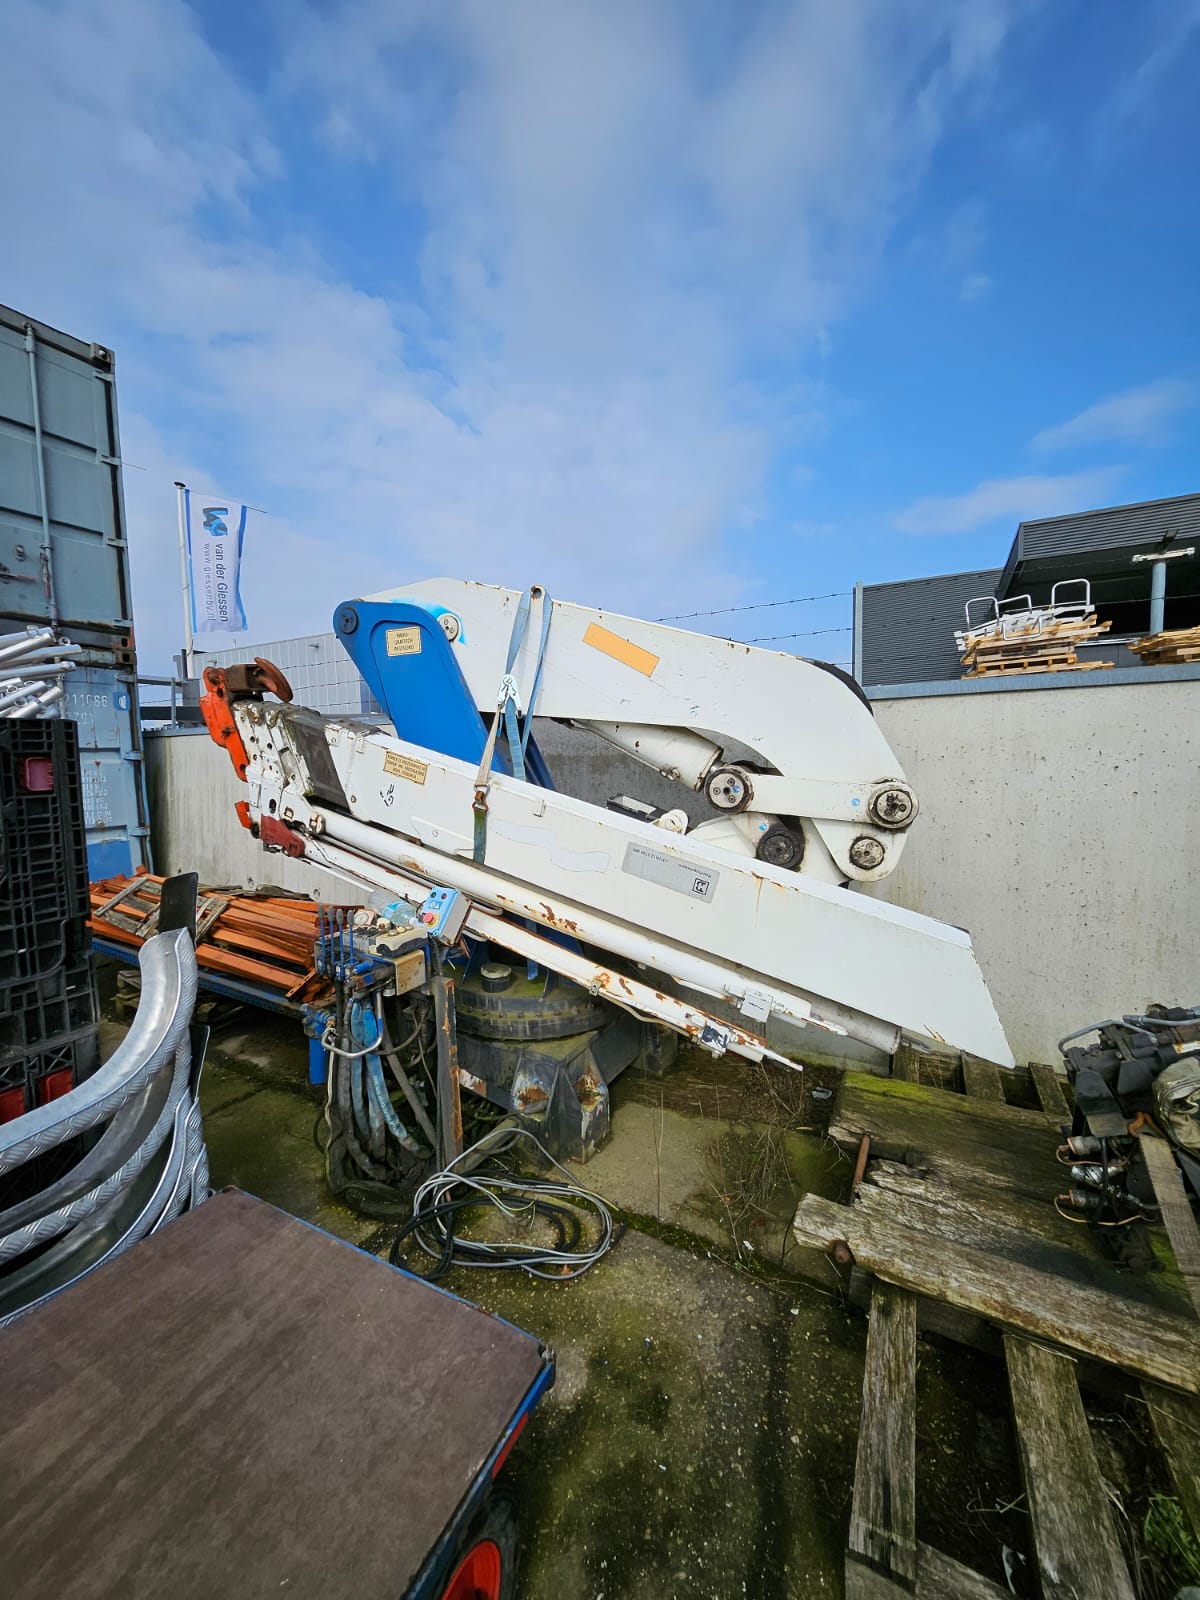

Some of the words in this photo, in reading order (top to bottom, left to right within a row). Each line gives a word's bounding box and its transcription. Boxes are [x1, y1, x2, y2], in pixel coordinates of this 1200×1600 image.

[215, 543, 224, 561] van
[203, 543, 216, 621] www.giessenbv.nl
[215, 563, 227, 580] der
[217, 582, 229, 622] Giessen
